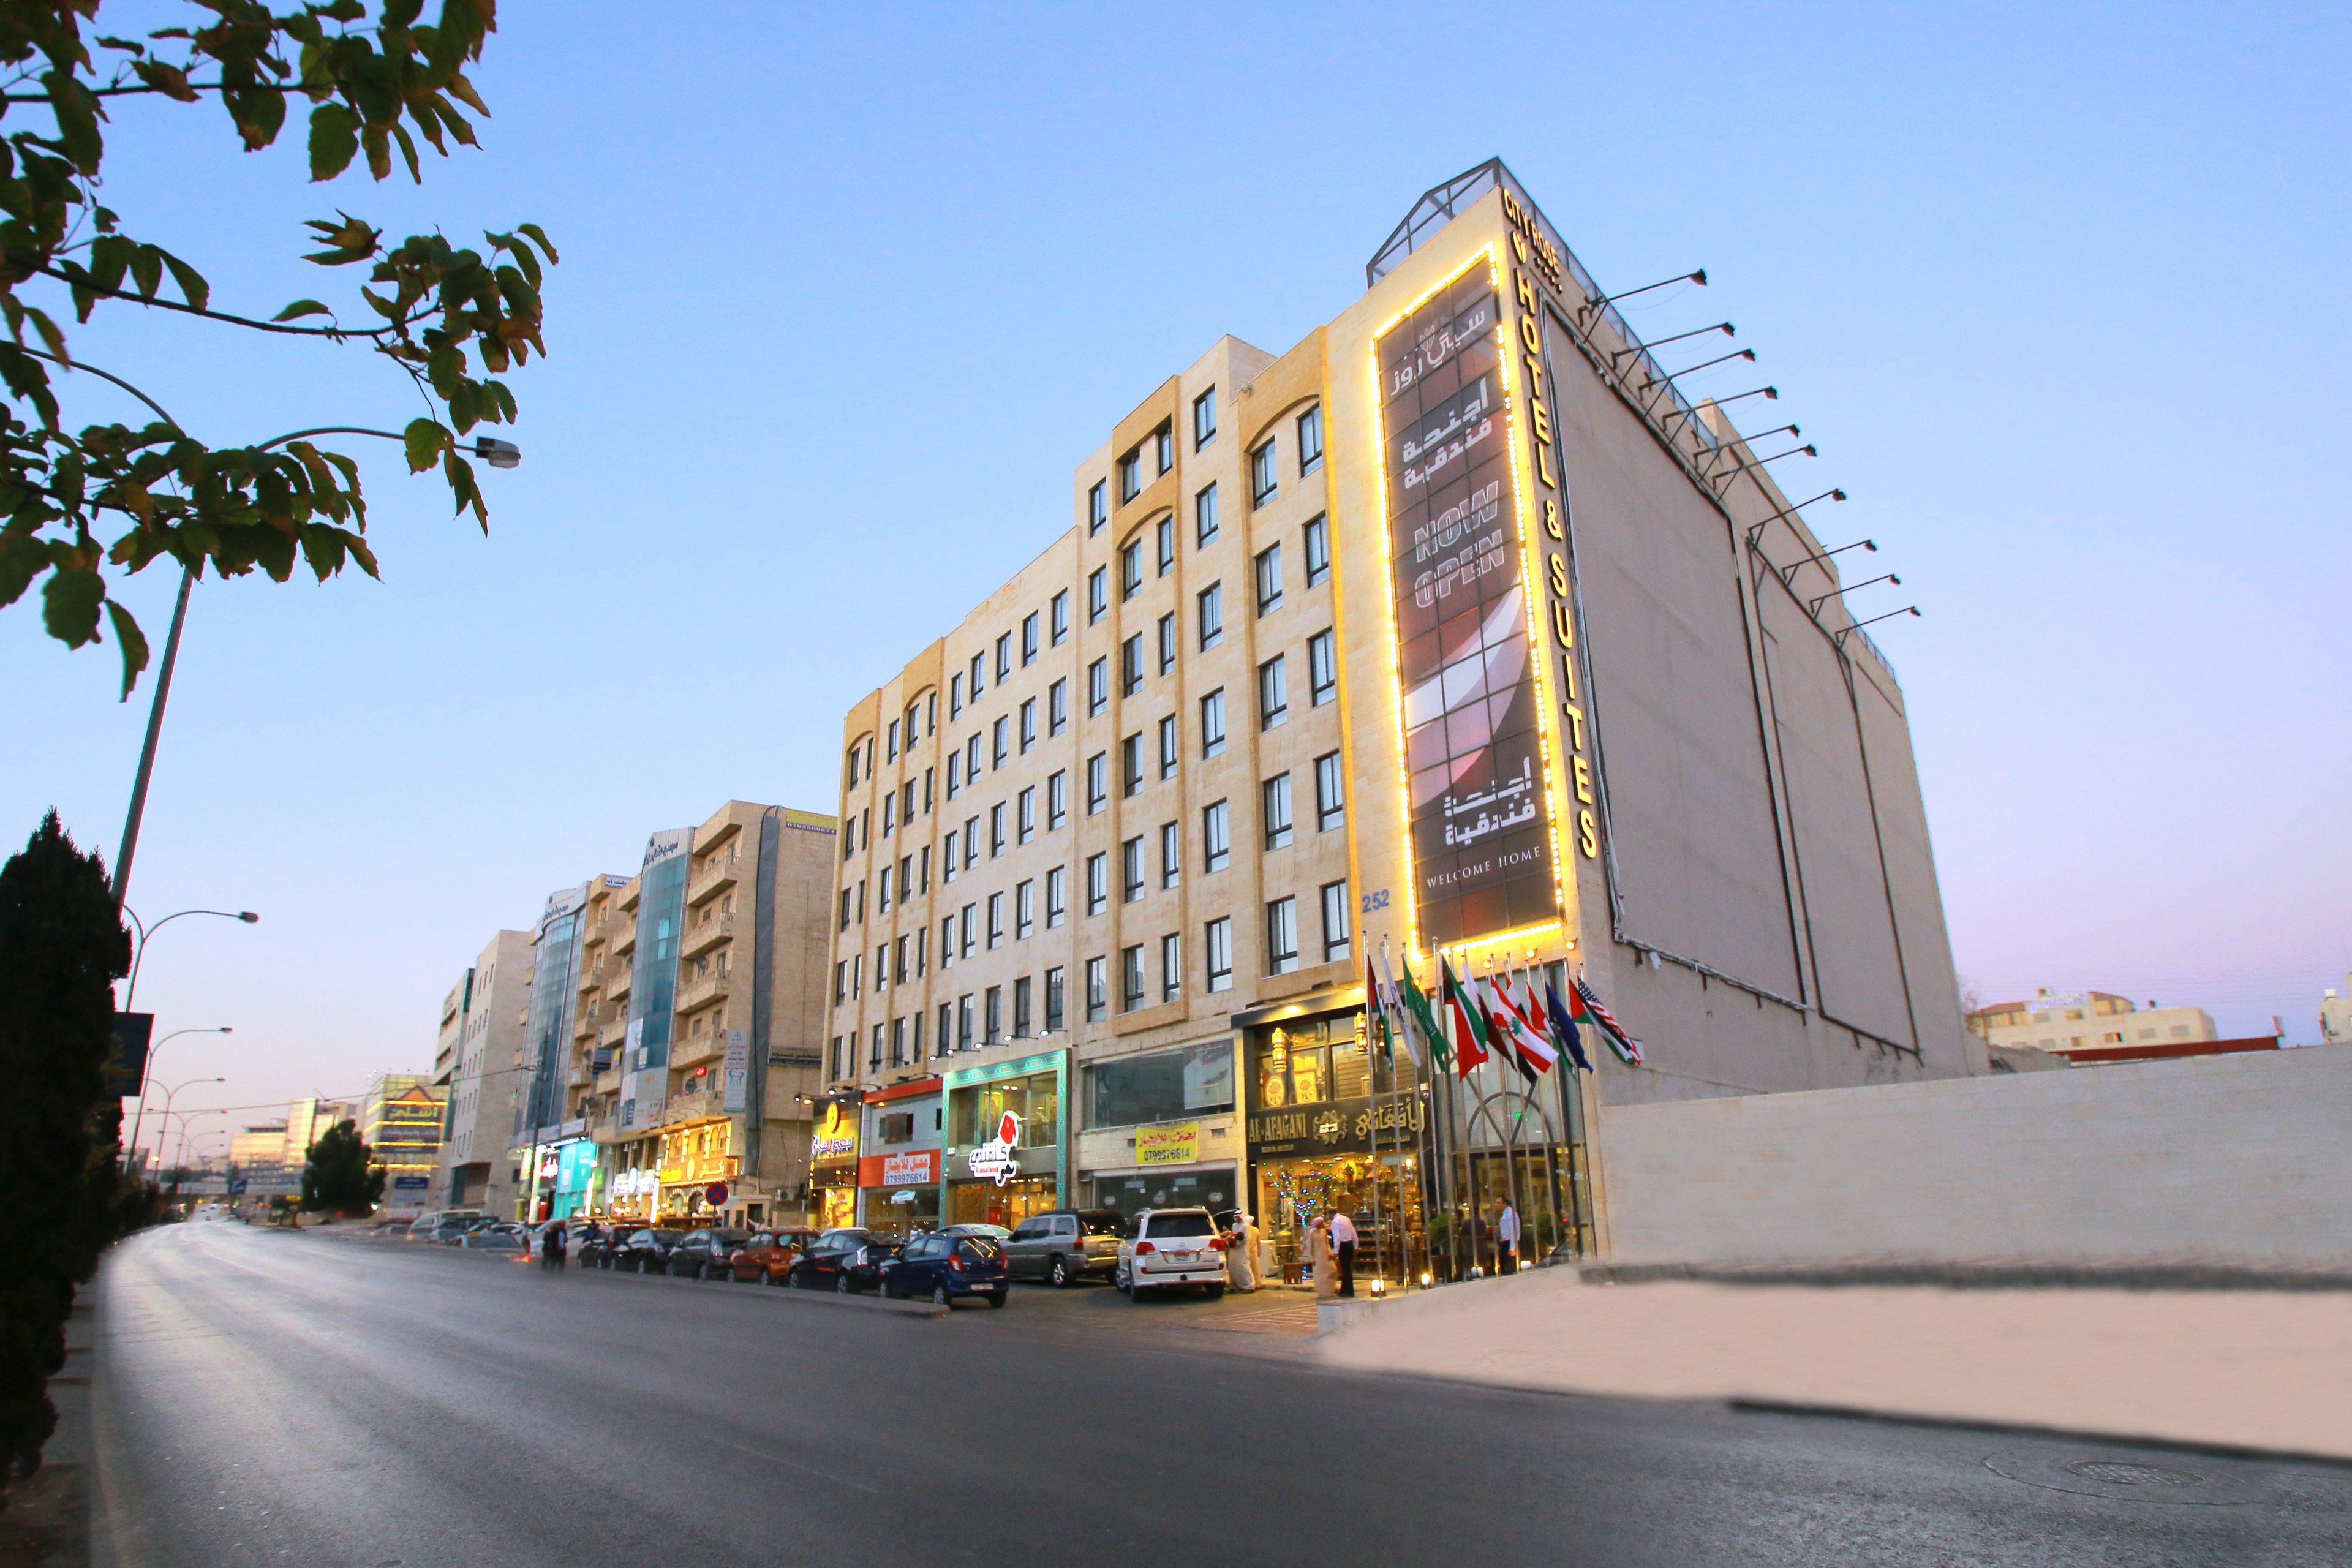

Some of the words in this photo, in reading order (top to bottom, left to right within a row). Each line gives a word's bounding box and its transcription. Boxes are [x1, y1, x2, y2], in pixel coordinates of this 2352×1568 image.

[1502, 187, 1529, 237] CITY
[1530, 221, 1560, 276] ROSE
[1427, 309, 1485, 369] سيتي
[1390, 358, 1423, 396] روز
[1515, 268, 1555, 489] HOTEL
[1404, 418, 1493, 489] فندقية
[1415, 480, 1499, 563] NOW
[1544, 500, 1563, 541] &
[1415, 528, 1505, 608] OPEN
[1549, 552, 1598, 859] SUITES
[1445, 797, 1536, 846] فندقية
[1427, 860, 1491, 888] WELCOME
[1498, 846, 1541, 868] HOME
[1362, 889, 1389, 913] 252
[885, 1172, 927, 1184] 0799976614
